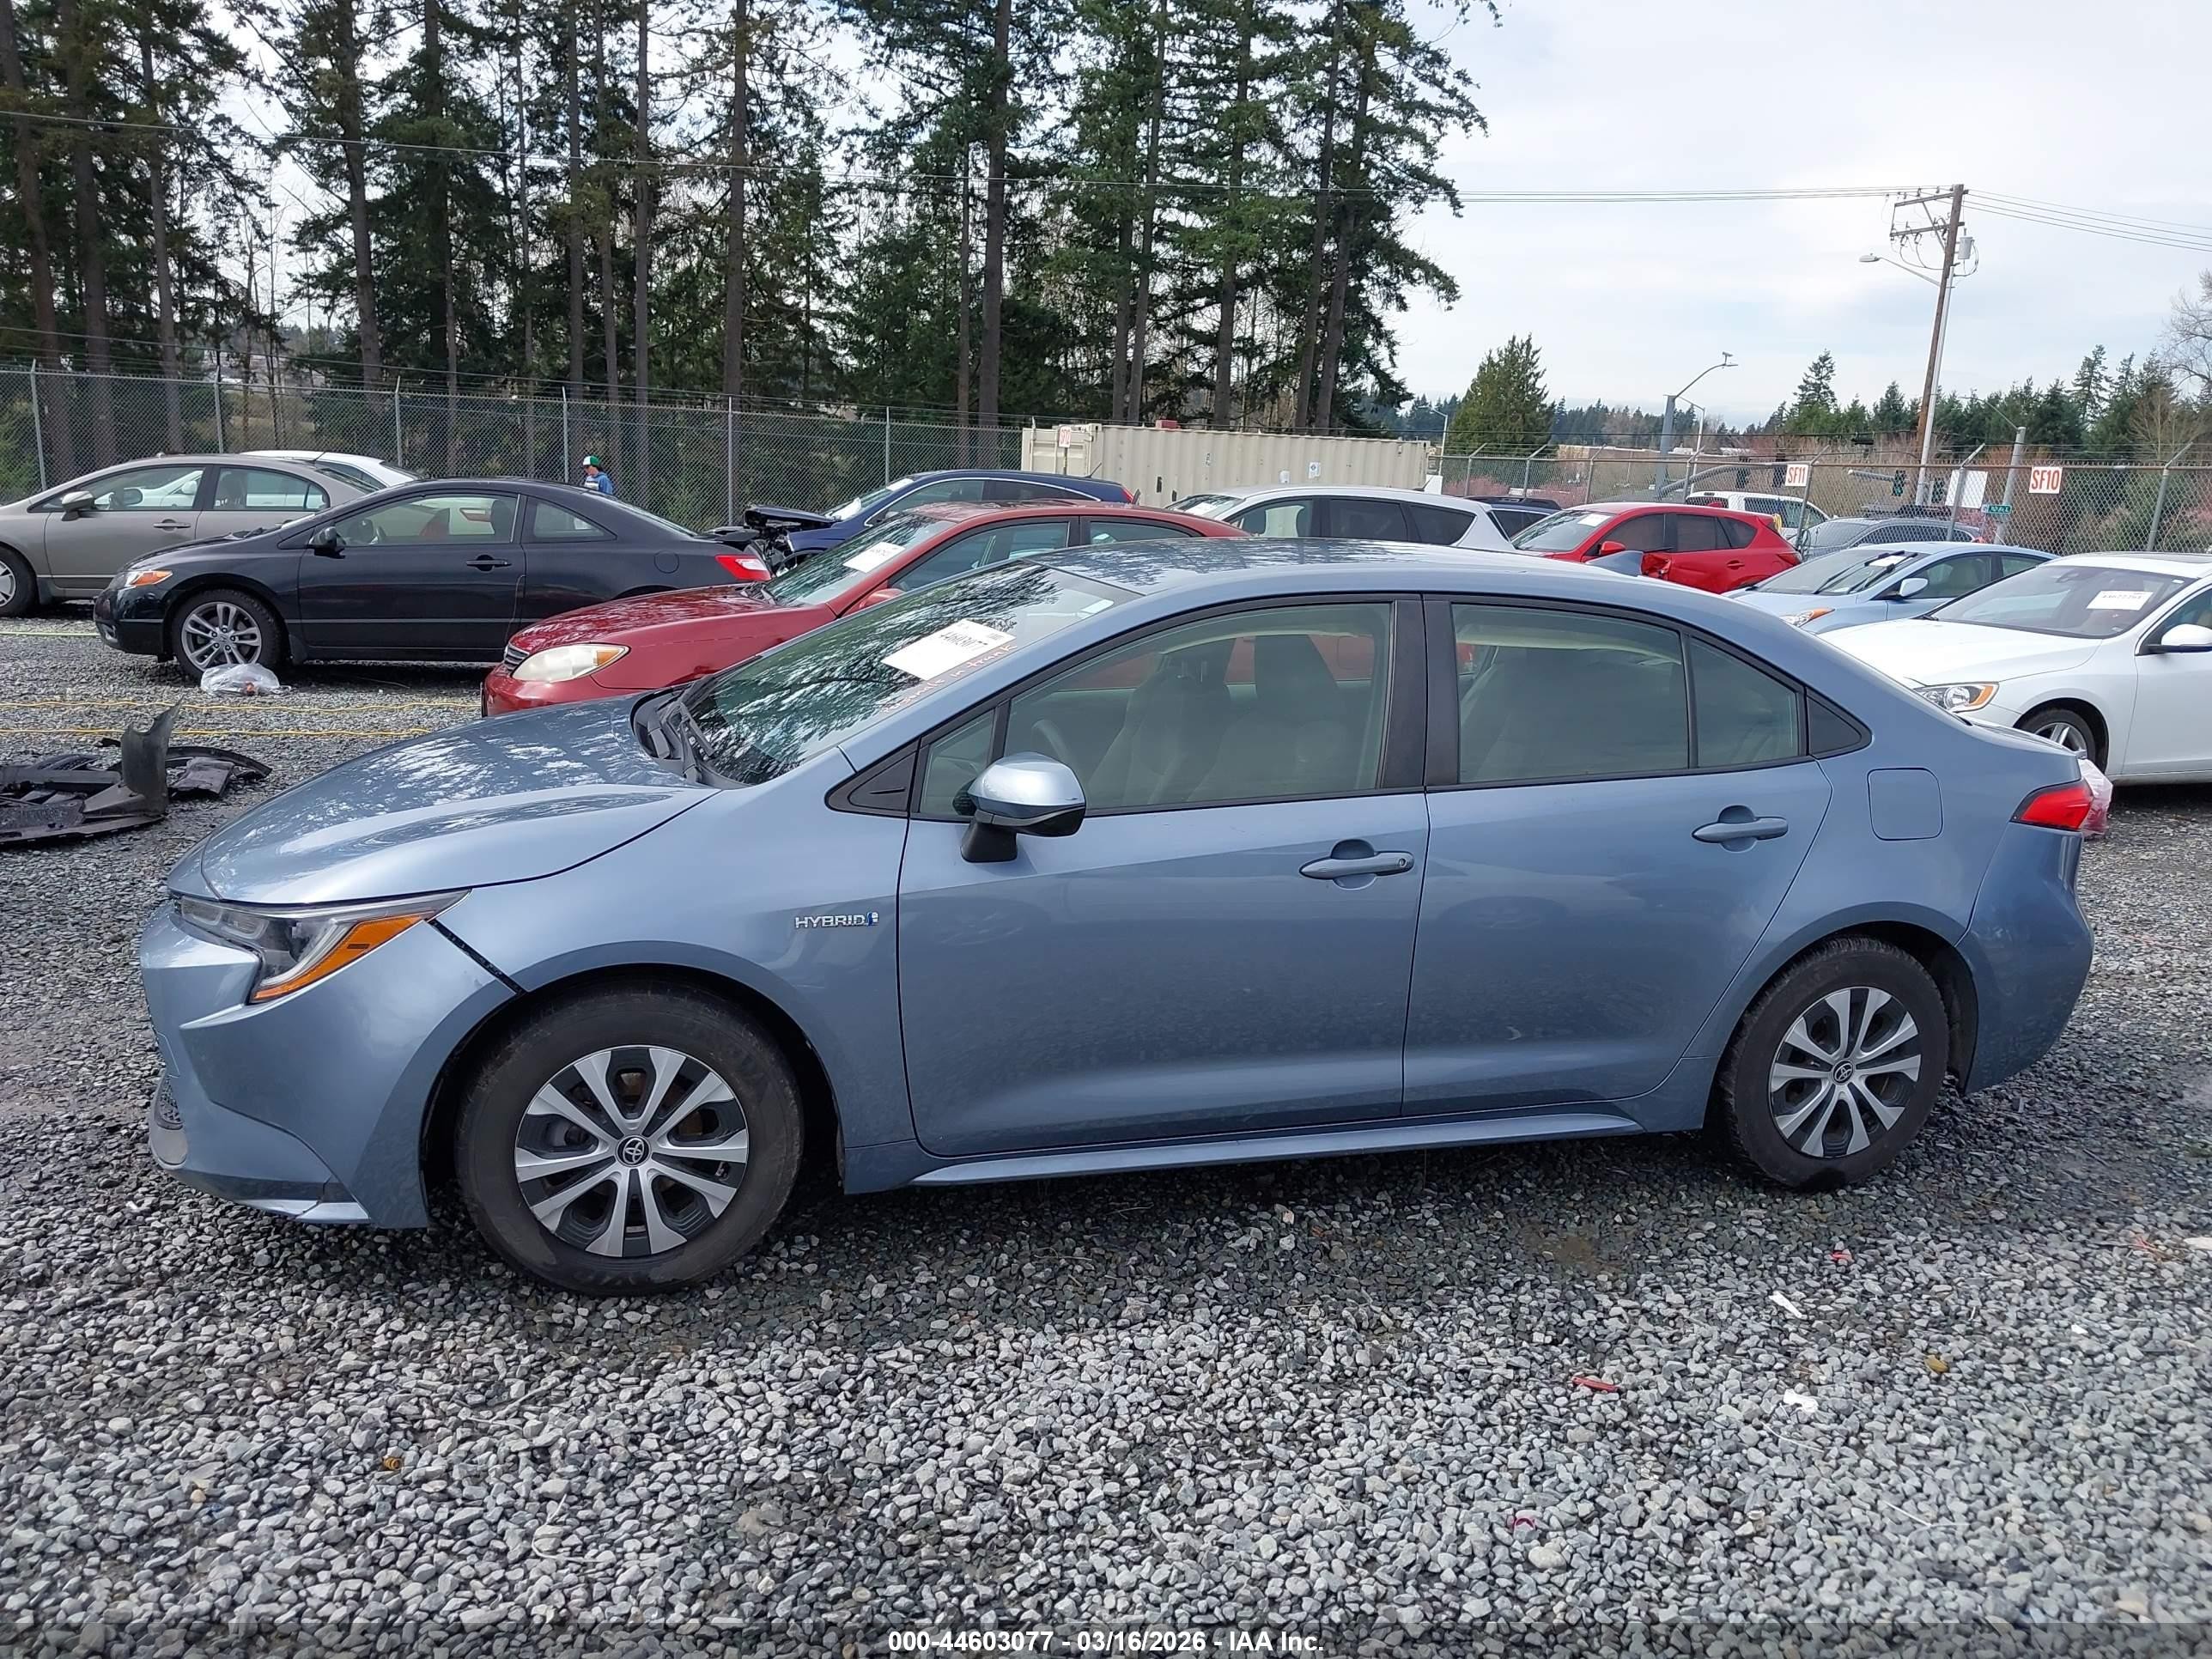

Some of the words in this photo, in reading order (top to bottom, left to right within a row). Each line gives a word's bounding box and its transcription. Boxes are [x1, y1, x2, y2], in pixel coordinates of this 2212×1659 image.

[1788, 466, 1807, 483] SF11
[2032, 470, 2060, 490] SF10
[967, 645, 1018, 668] trunk
[795, 915, 866, 928] HYBRID
